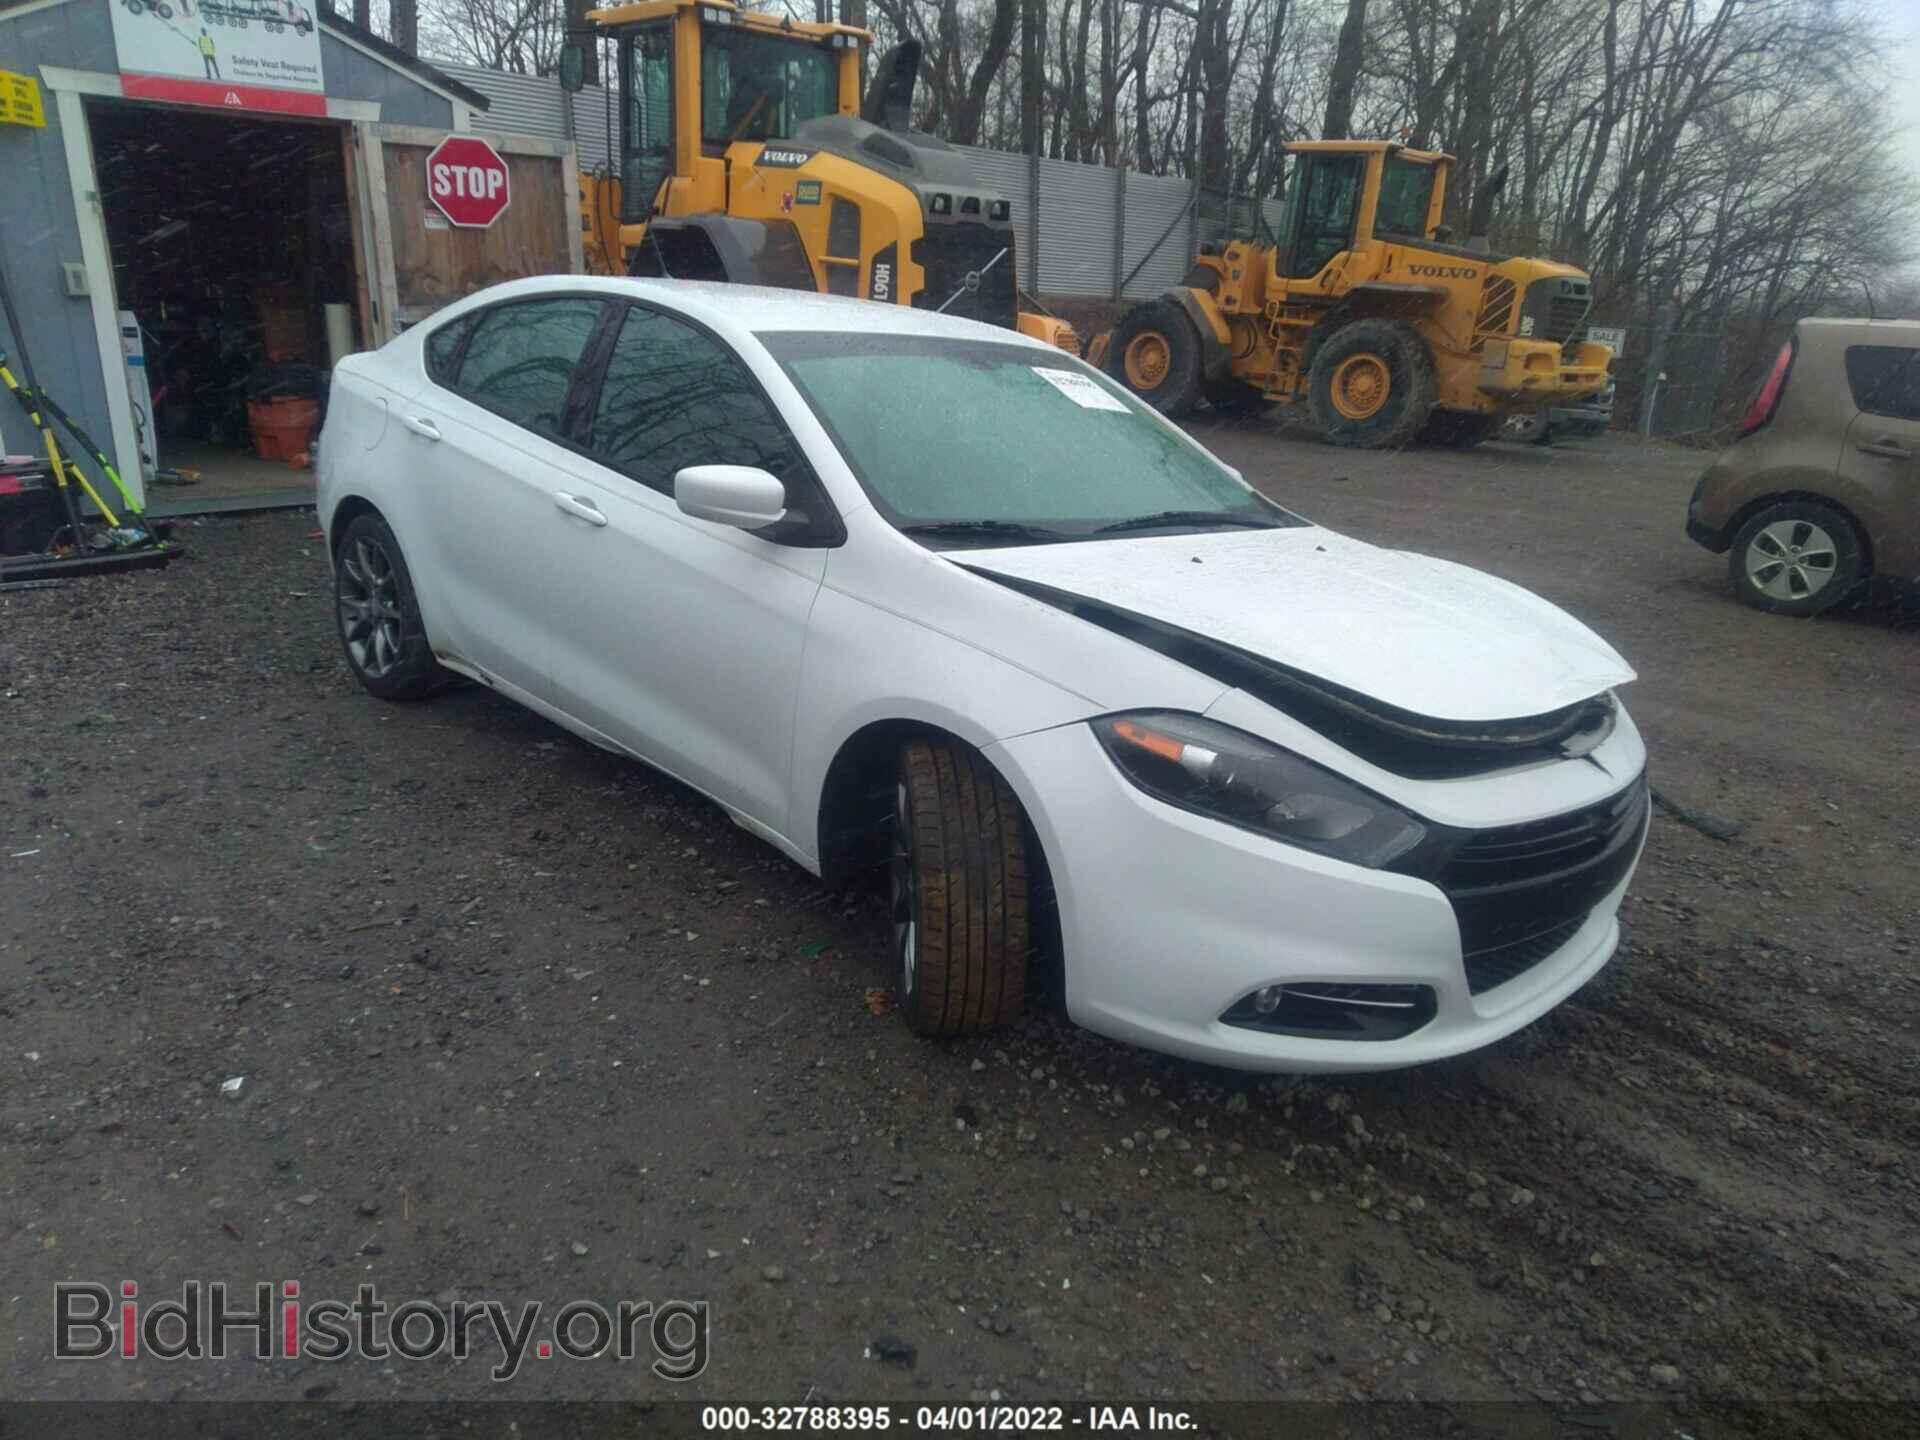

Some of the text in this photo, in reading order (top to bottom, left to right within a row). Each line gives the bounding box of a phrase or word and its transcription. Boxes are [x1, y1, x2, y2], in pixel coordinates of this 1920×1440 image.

[232, 55, 317, 74] Safety Vest Required
[763, 150, 808, 165] VOLVO
[433, 163, 504, 200] STOP
[1408, 264, 1477, 280] VOLVO
[873, 263, 891, 301] L90H
